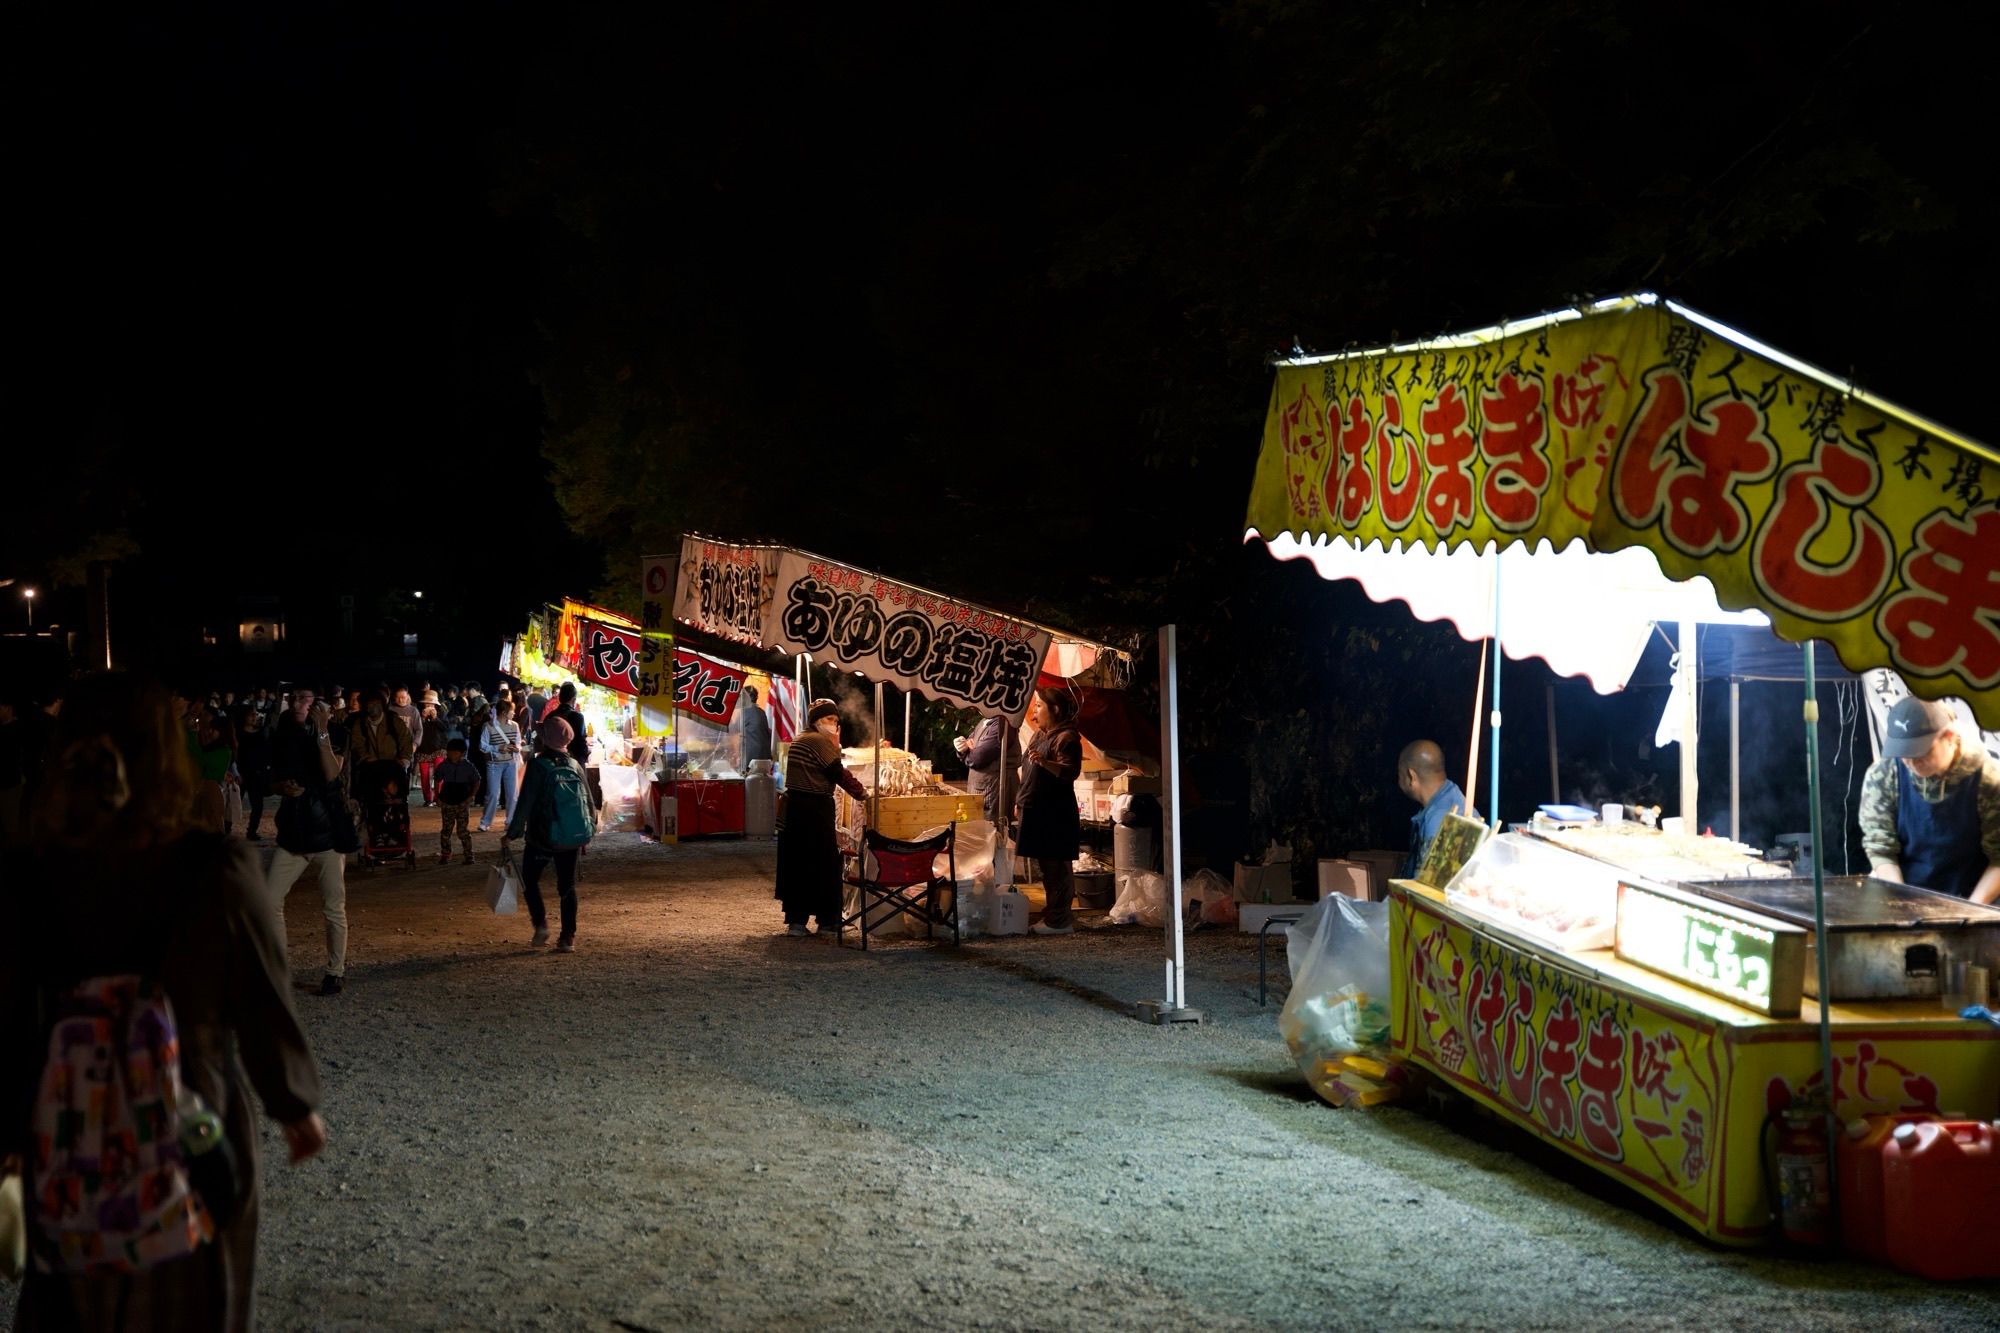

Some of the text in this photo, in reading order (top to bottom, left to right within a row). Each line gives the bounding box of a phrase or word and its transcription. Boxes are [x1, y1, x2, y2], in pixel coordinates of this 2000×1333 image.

[1323, 372, 1552, 536] はしまき
[1664, 326, 2000, 508] 職人が焼く本場
[782, 576, 1038, 714] あゆの塩焼
[808, 562, 864, 594] 味自慢
[587, 630, 741, 715] やそば
[1463, 961, 1627, 1163] はしまき
